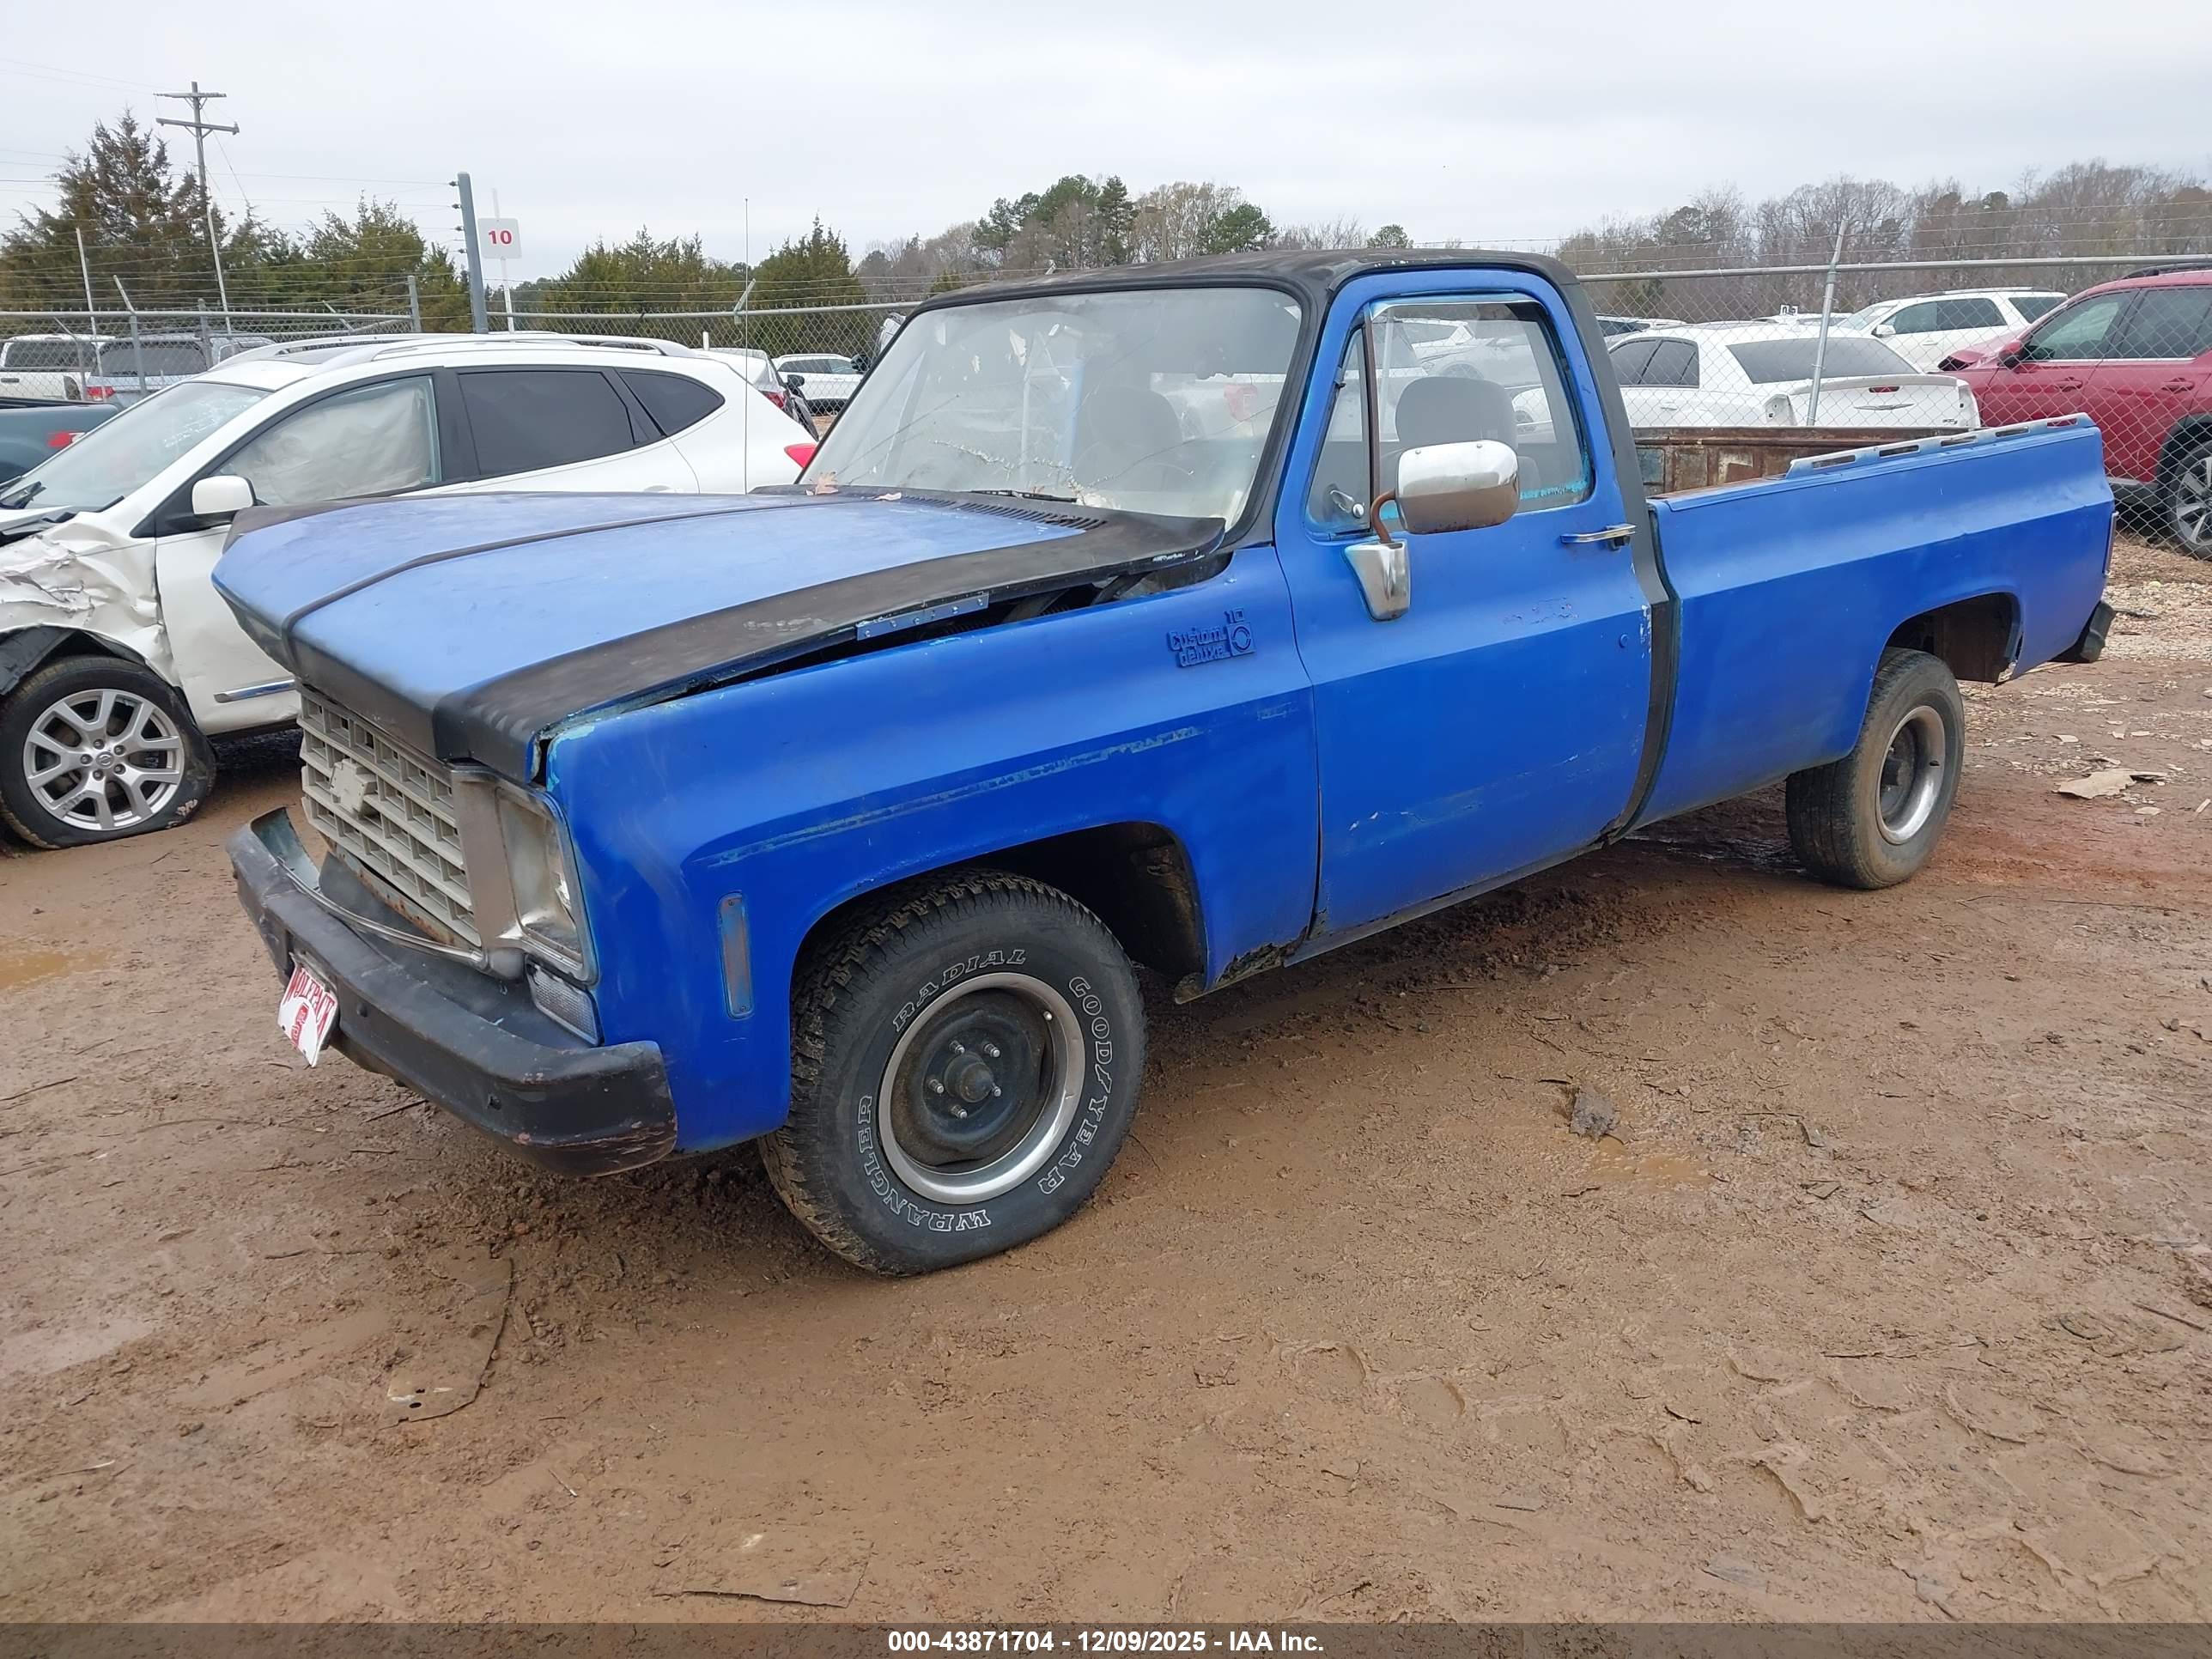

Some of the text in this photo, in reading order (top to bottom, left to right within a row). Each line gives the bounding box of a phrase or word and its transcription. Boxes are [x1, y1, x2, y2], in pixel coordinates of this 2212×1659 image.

[489, 230, 512, 245] 10
[893, 949, 1028, 1032] RADIAL
[1037, 976, 1113, 1194] GOODYEAR
[859, 1096, 991, 1231] WRANGLER
